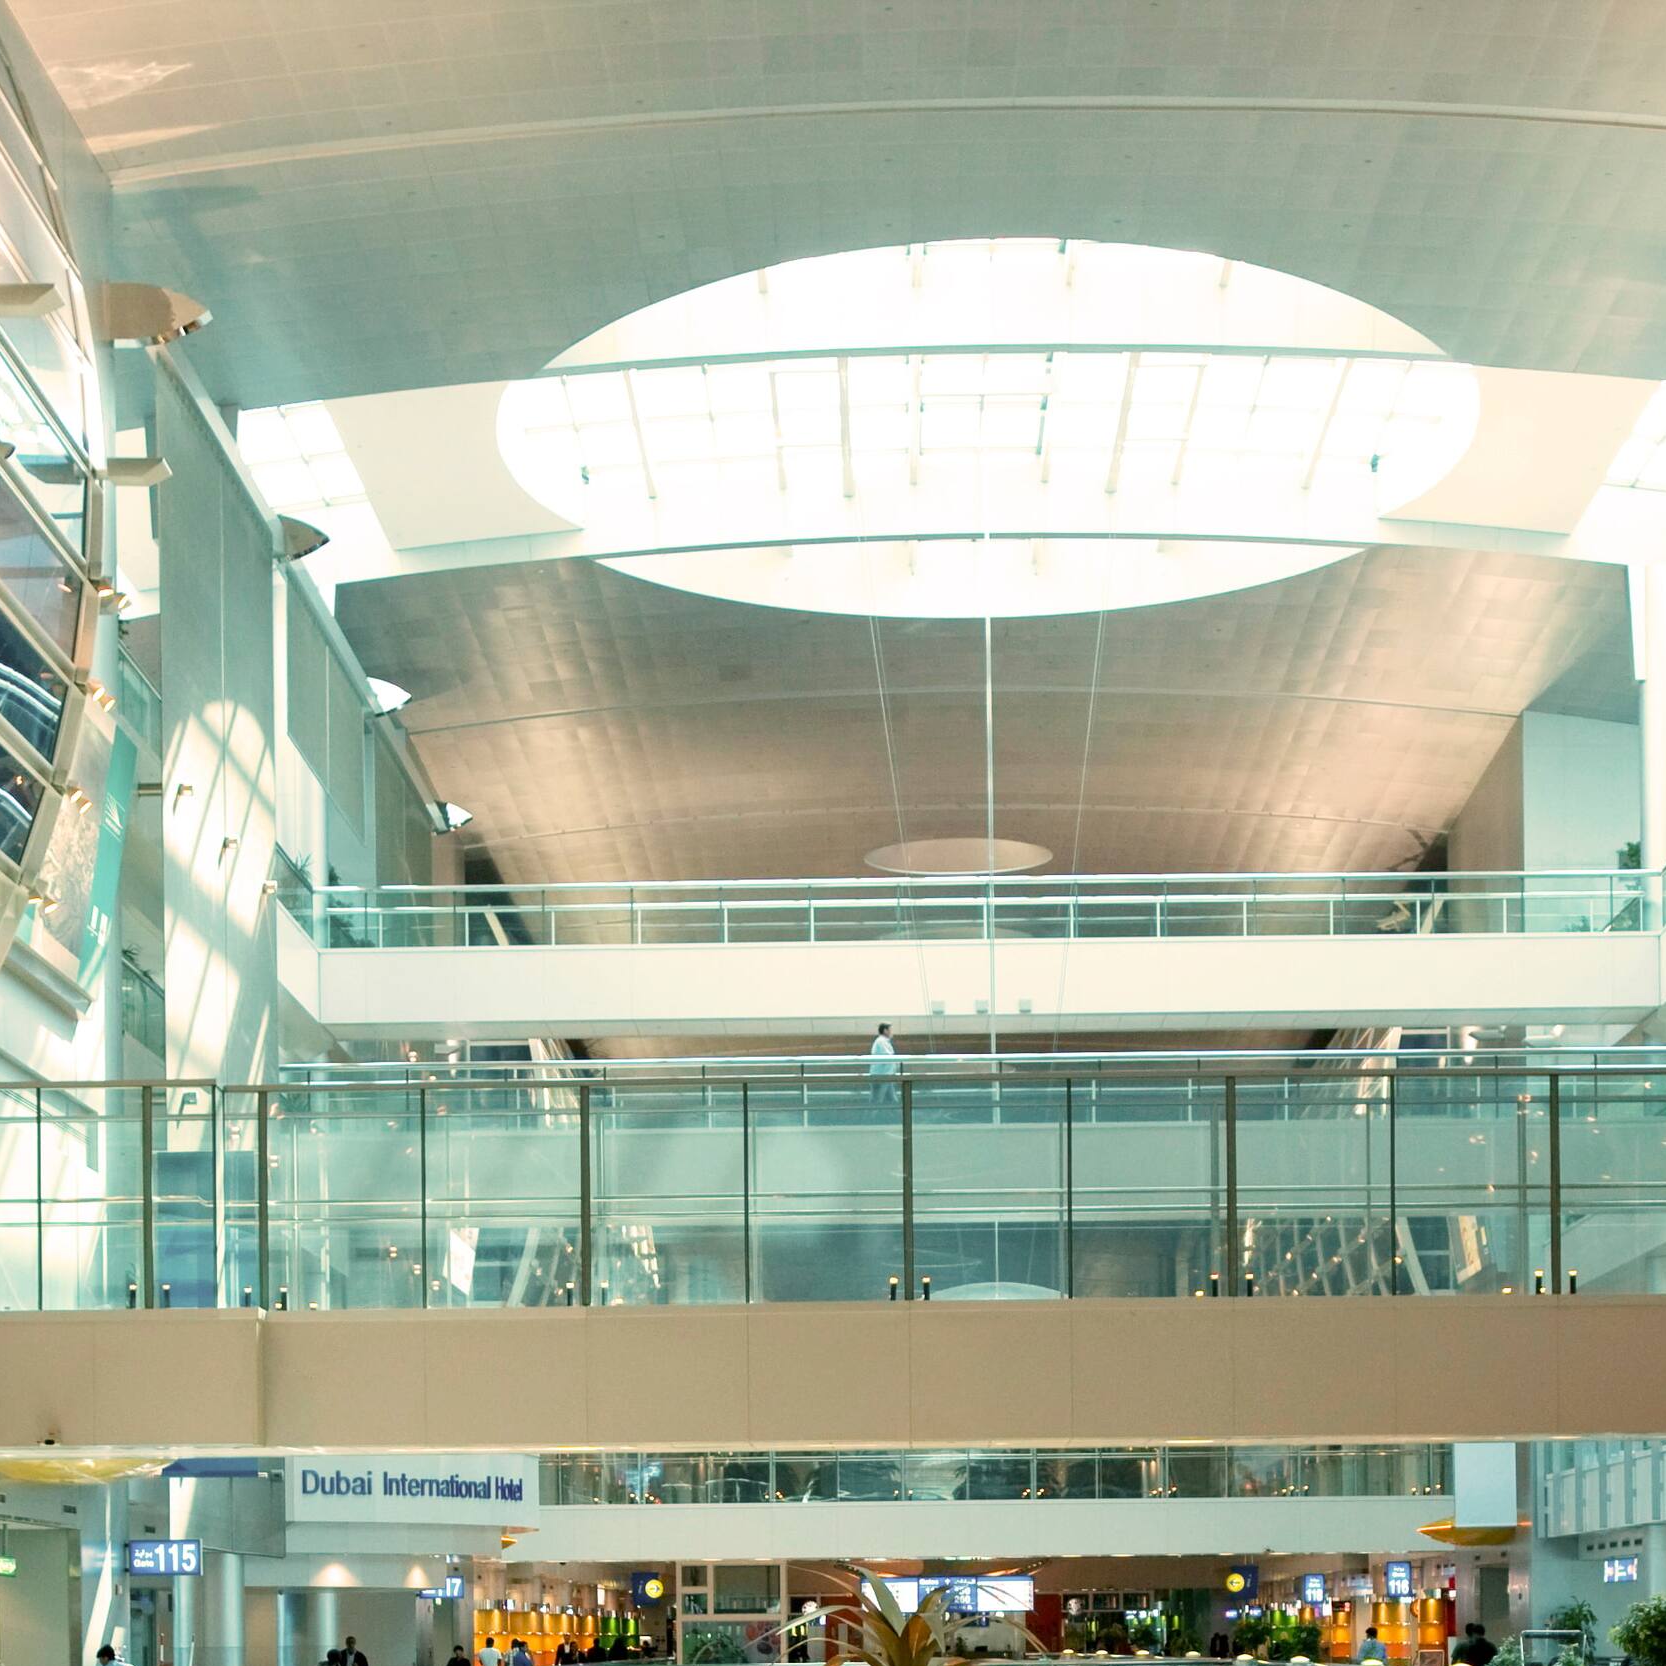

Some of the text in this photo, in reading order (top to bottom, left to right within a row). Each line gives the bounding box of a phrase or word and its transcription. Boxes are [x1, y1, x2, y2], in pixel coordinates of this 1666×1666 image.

[301, 1469, 523, 1501] Dubai International Hotel
[133, 1543, 197, 1572] Gate 115
